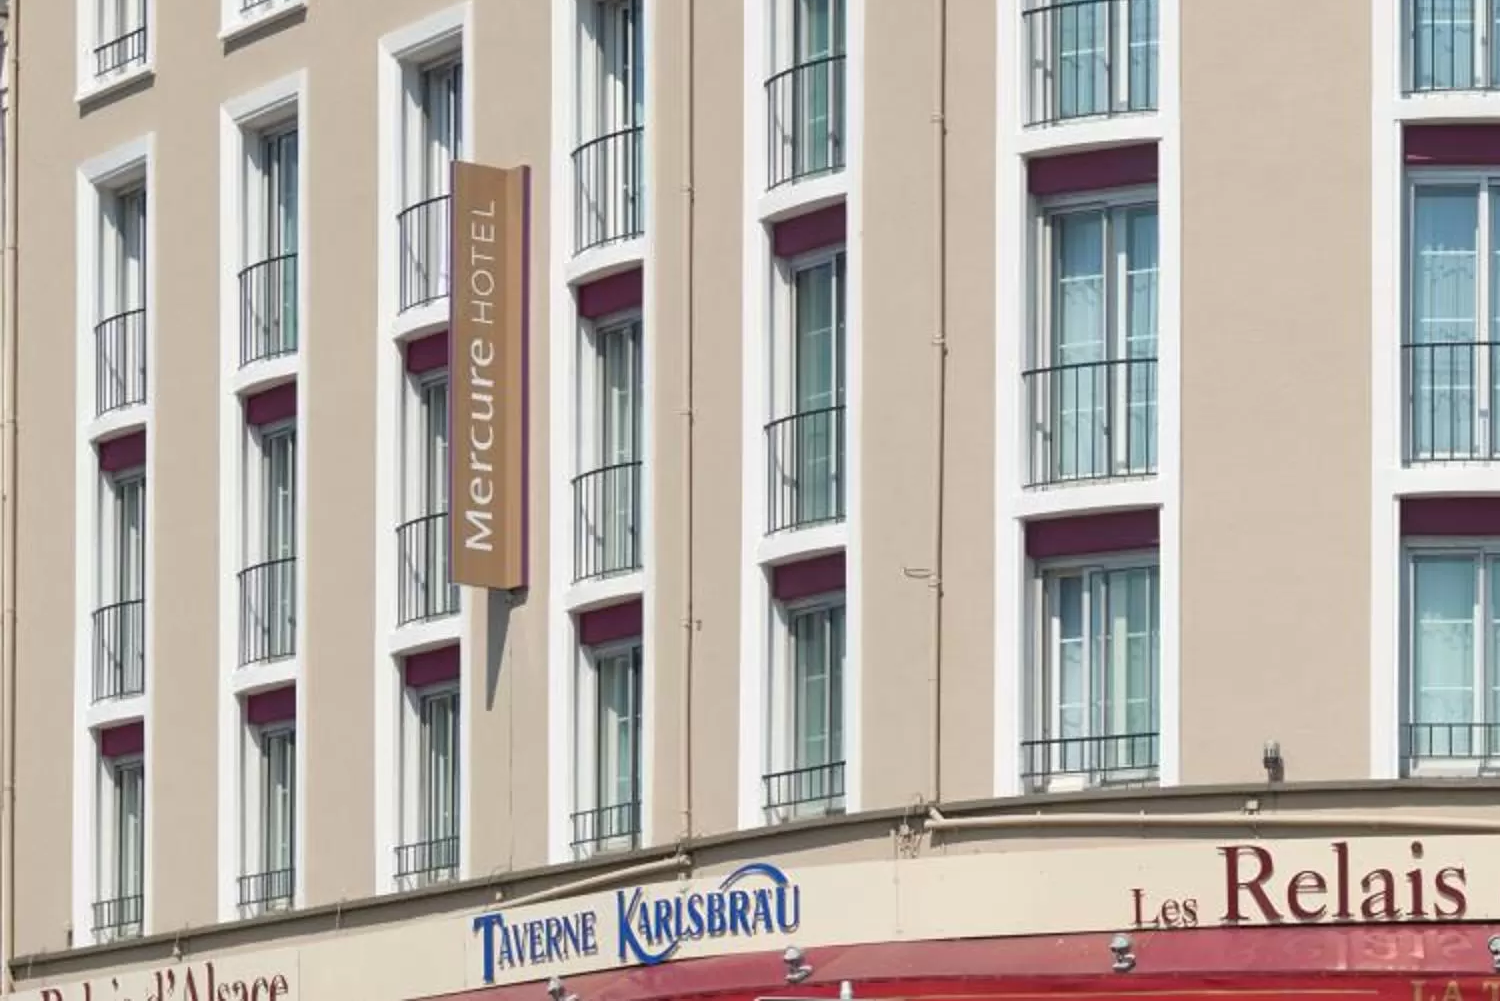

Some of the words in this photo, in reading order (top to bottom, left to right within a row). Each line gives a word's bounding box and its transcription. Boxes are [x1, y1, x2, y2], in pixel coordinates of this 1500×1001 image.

[470, 199, 495, 324] HOTEL
[465, 338, 496, 552] Mercure
[473, 909, 599, 985] TAVERNE
[616, 863, 801, 965] KARLSBRÄU
[1129, 887, 1199, 928] Les
[1216, 841, 1469, 925] Relais
[1410, 979, 1464, 1001] LA
